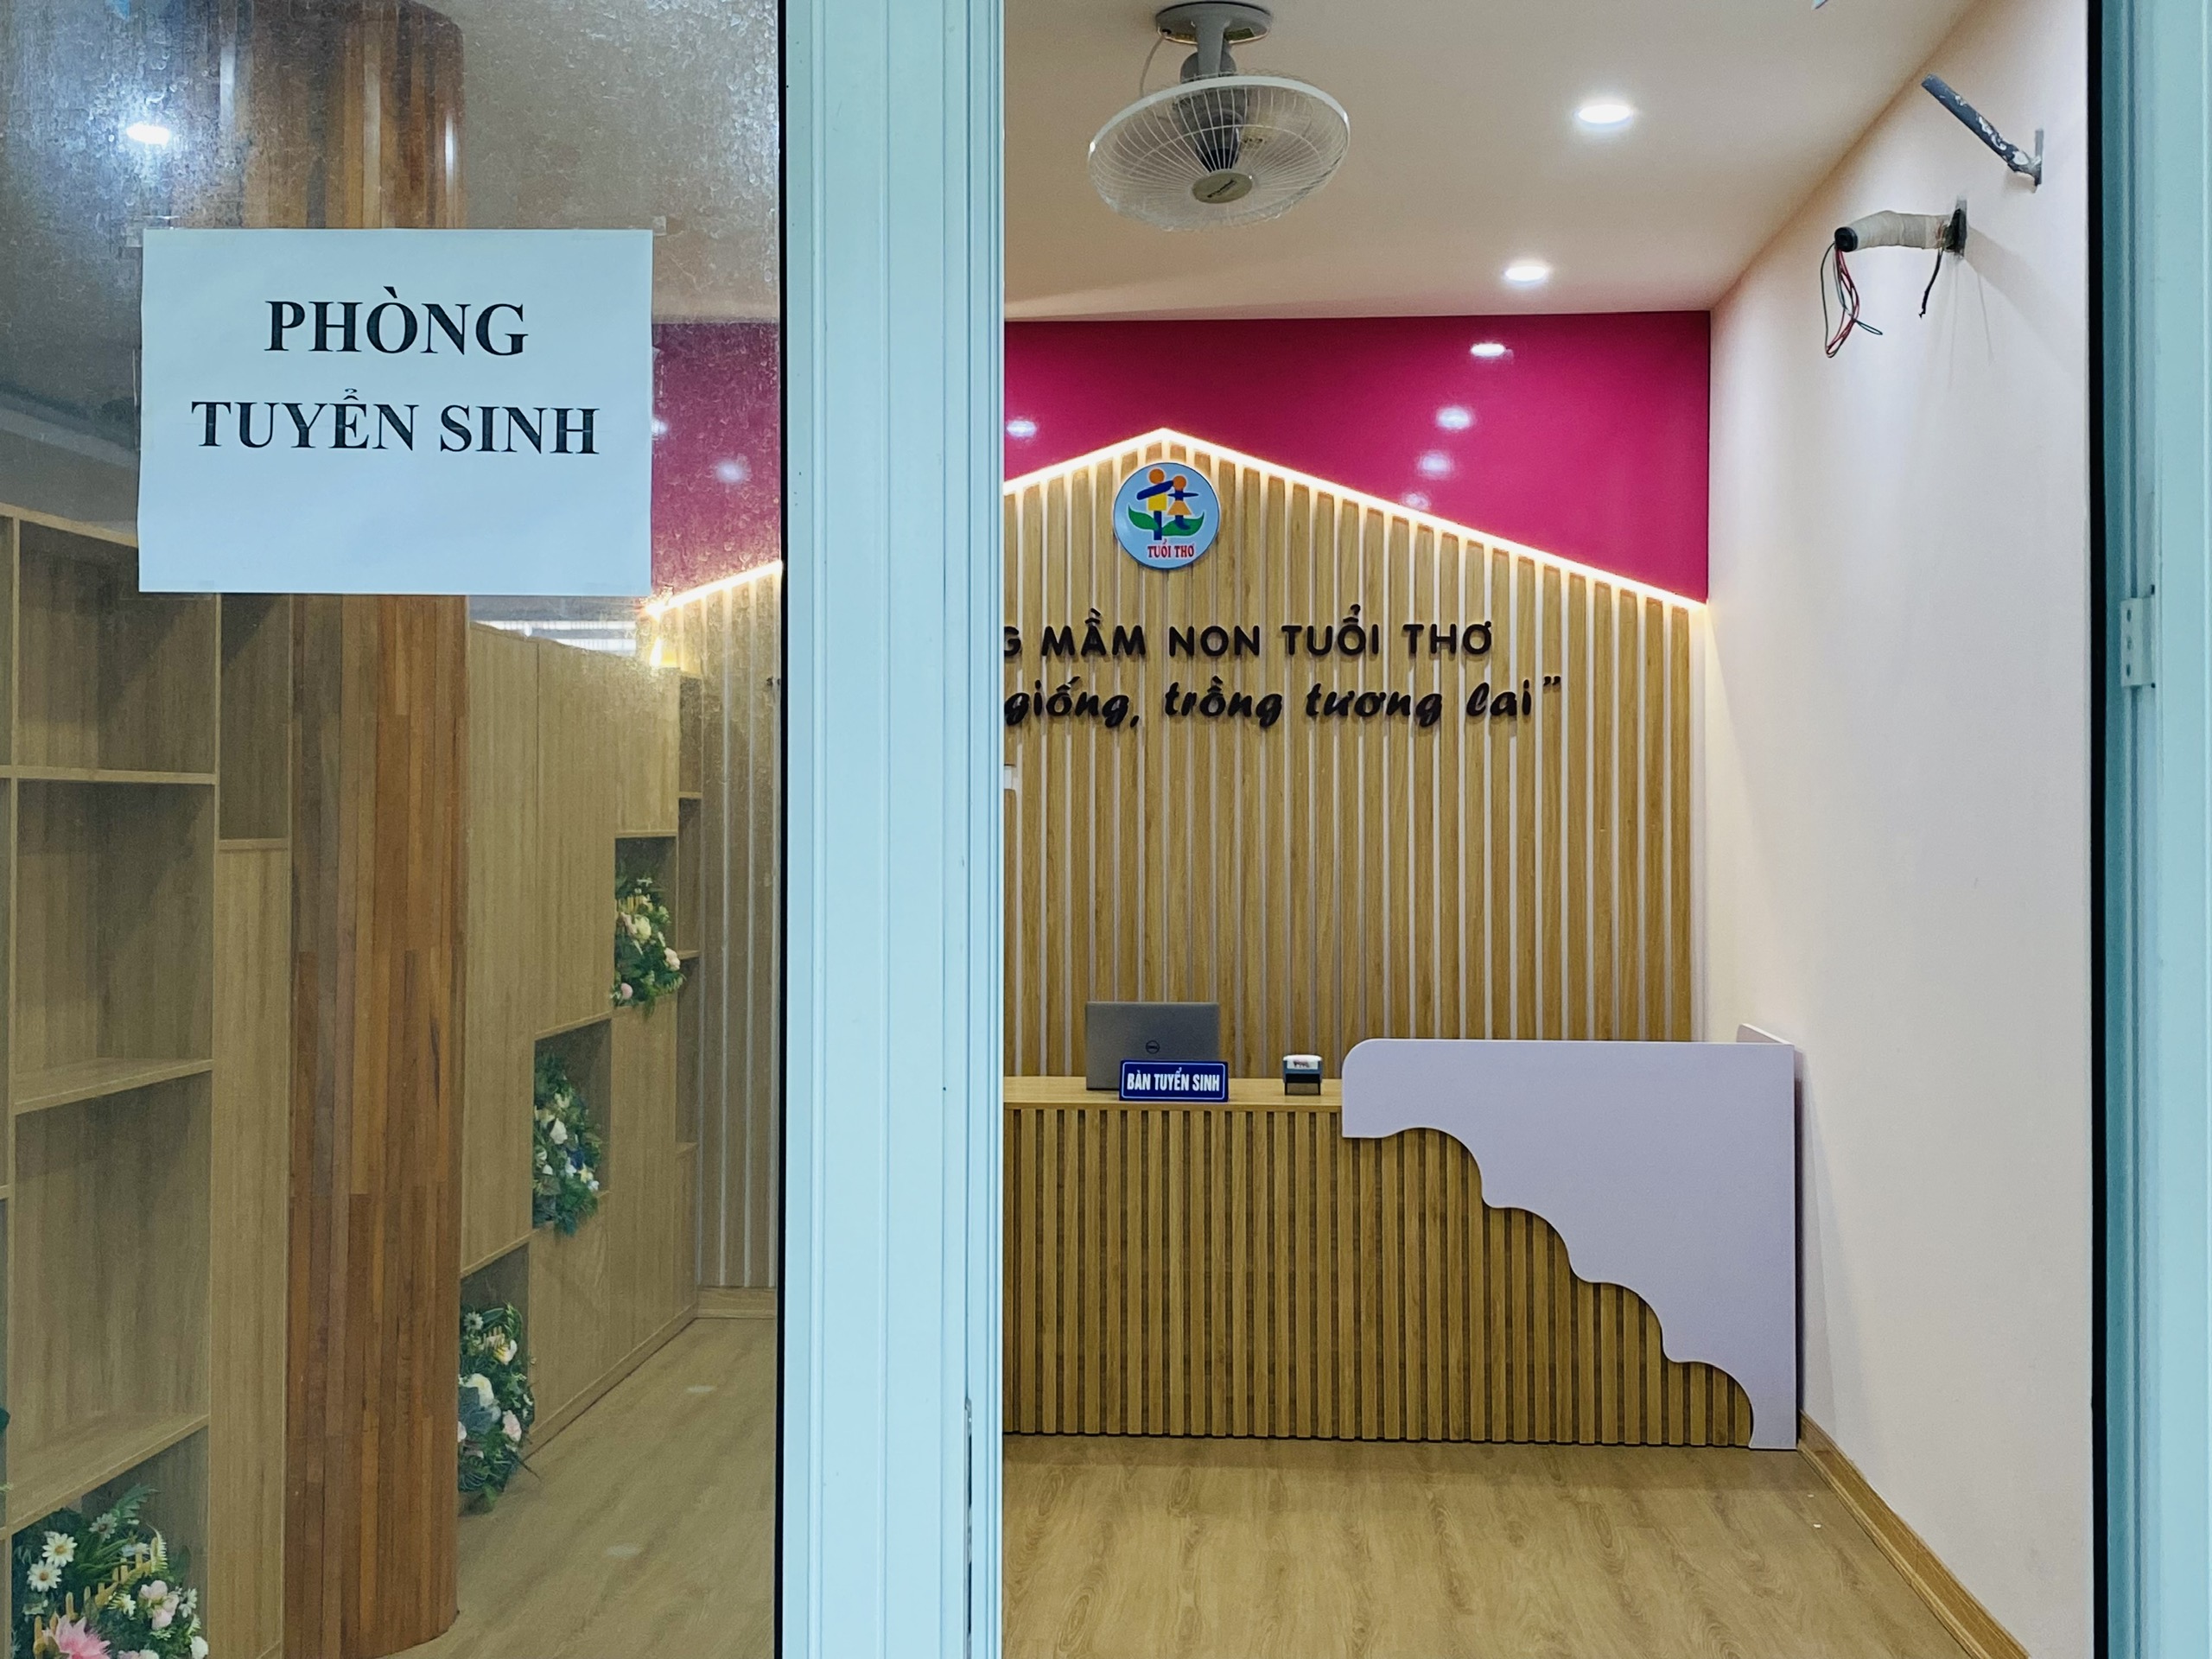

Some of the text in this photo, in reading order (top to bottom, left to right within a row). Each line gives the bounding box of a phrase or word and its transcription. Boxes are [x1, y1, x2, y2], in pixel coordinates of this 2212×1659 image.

[264, 286, 529, 356] PHÒNG
[192, 388, 600, 454] TUYỂN SINH
[1041, 607, 1146, 657] MẦM
[1169, 626, 1260, 657] NON
[1281, 604, 1379, 656] TUỔI
[1402, 621, 1492, 655] THƠ
[1004, 676, 1140, 728] giống,
[1165, 676, 1282, 728] trồng
[1306, 683, 1442, 728] tương
[1127, 1066, 1220, 1091] BÀN TUYỂN SINH
